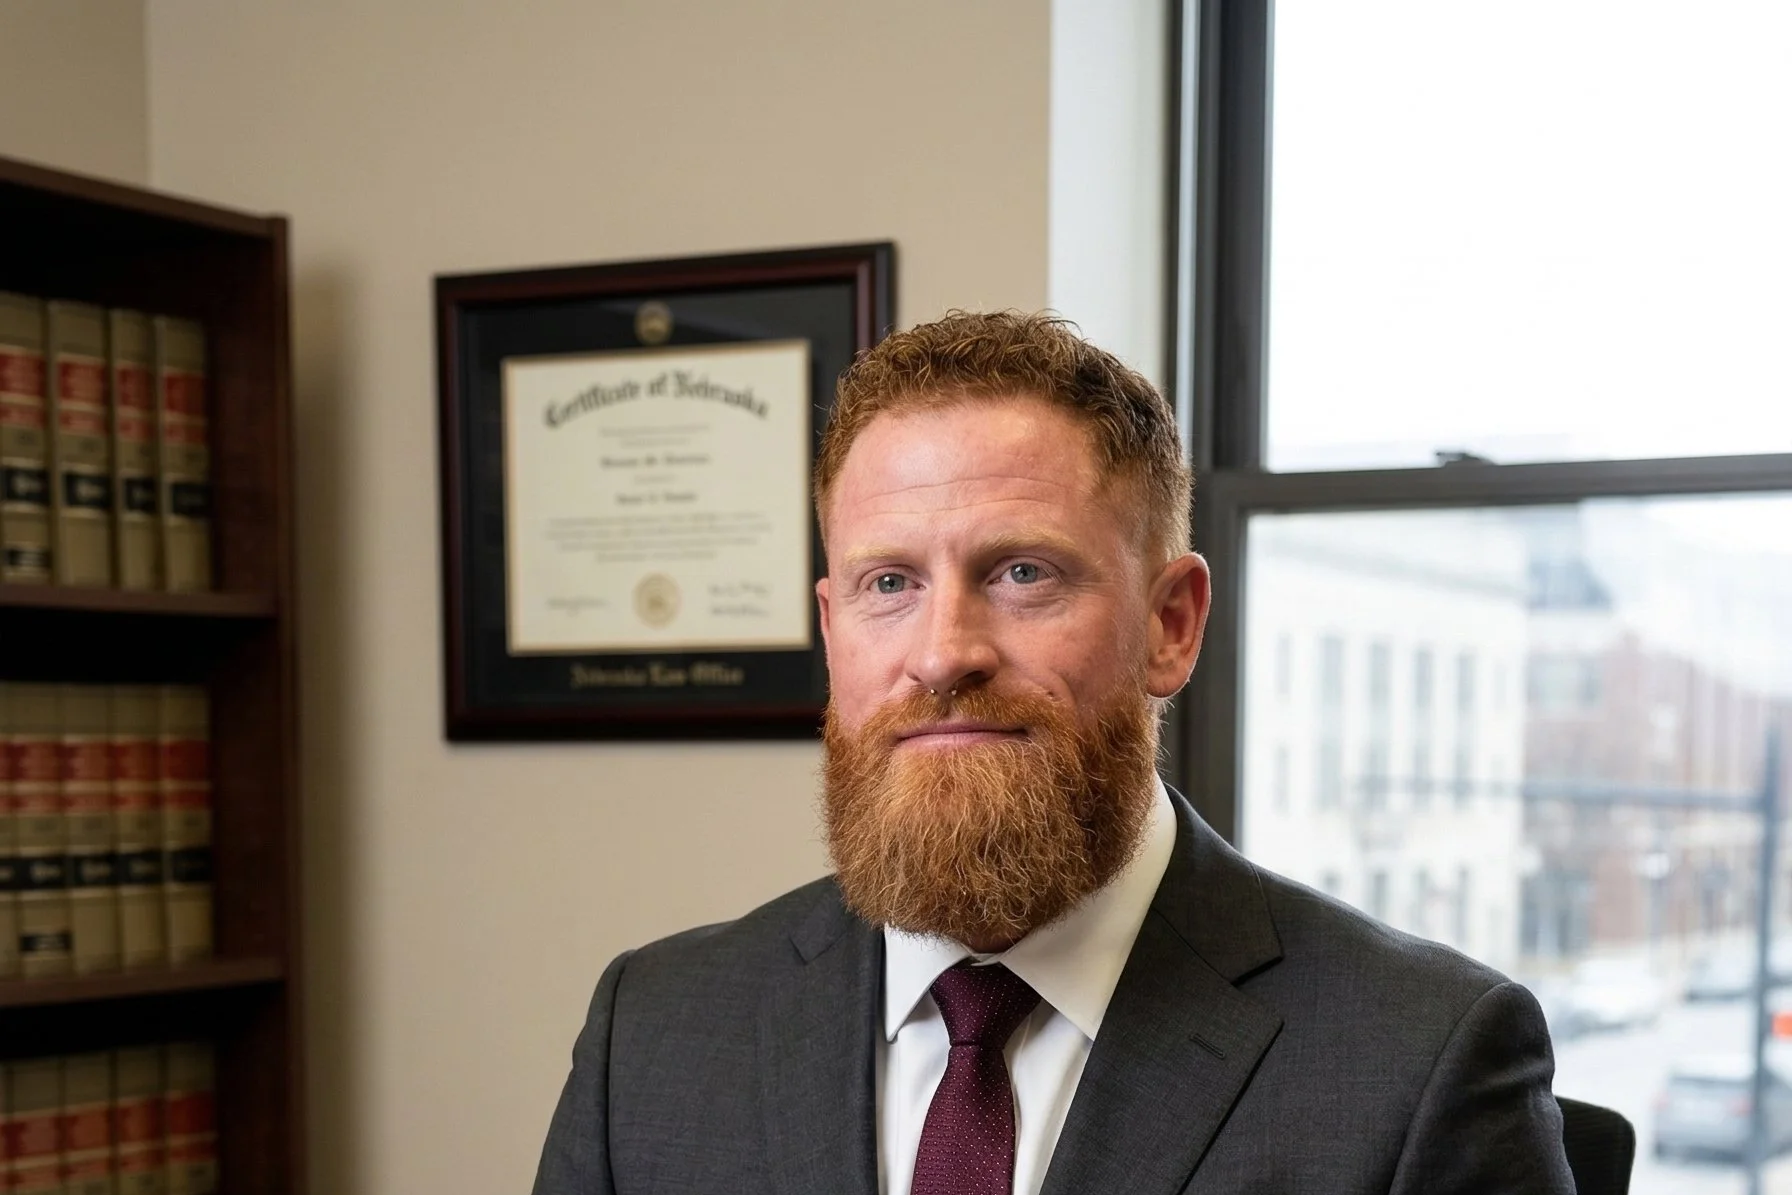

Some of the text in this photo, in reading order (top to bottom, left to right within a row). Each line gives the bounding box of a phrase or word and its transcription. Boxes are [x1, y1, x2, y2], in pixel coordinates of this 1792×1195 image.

[543, 370, 769, 429] Certificate of Nebraska
